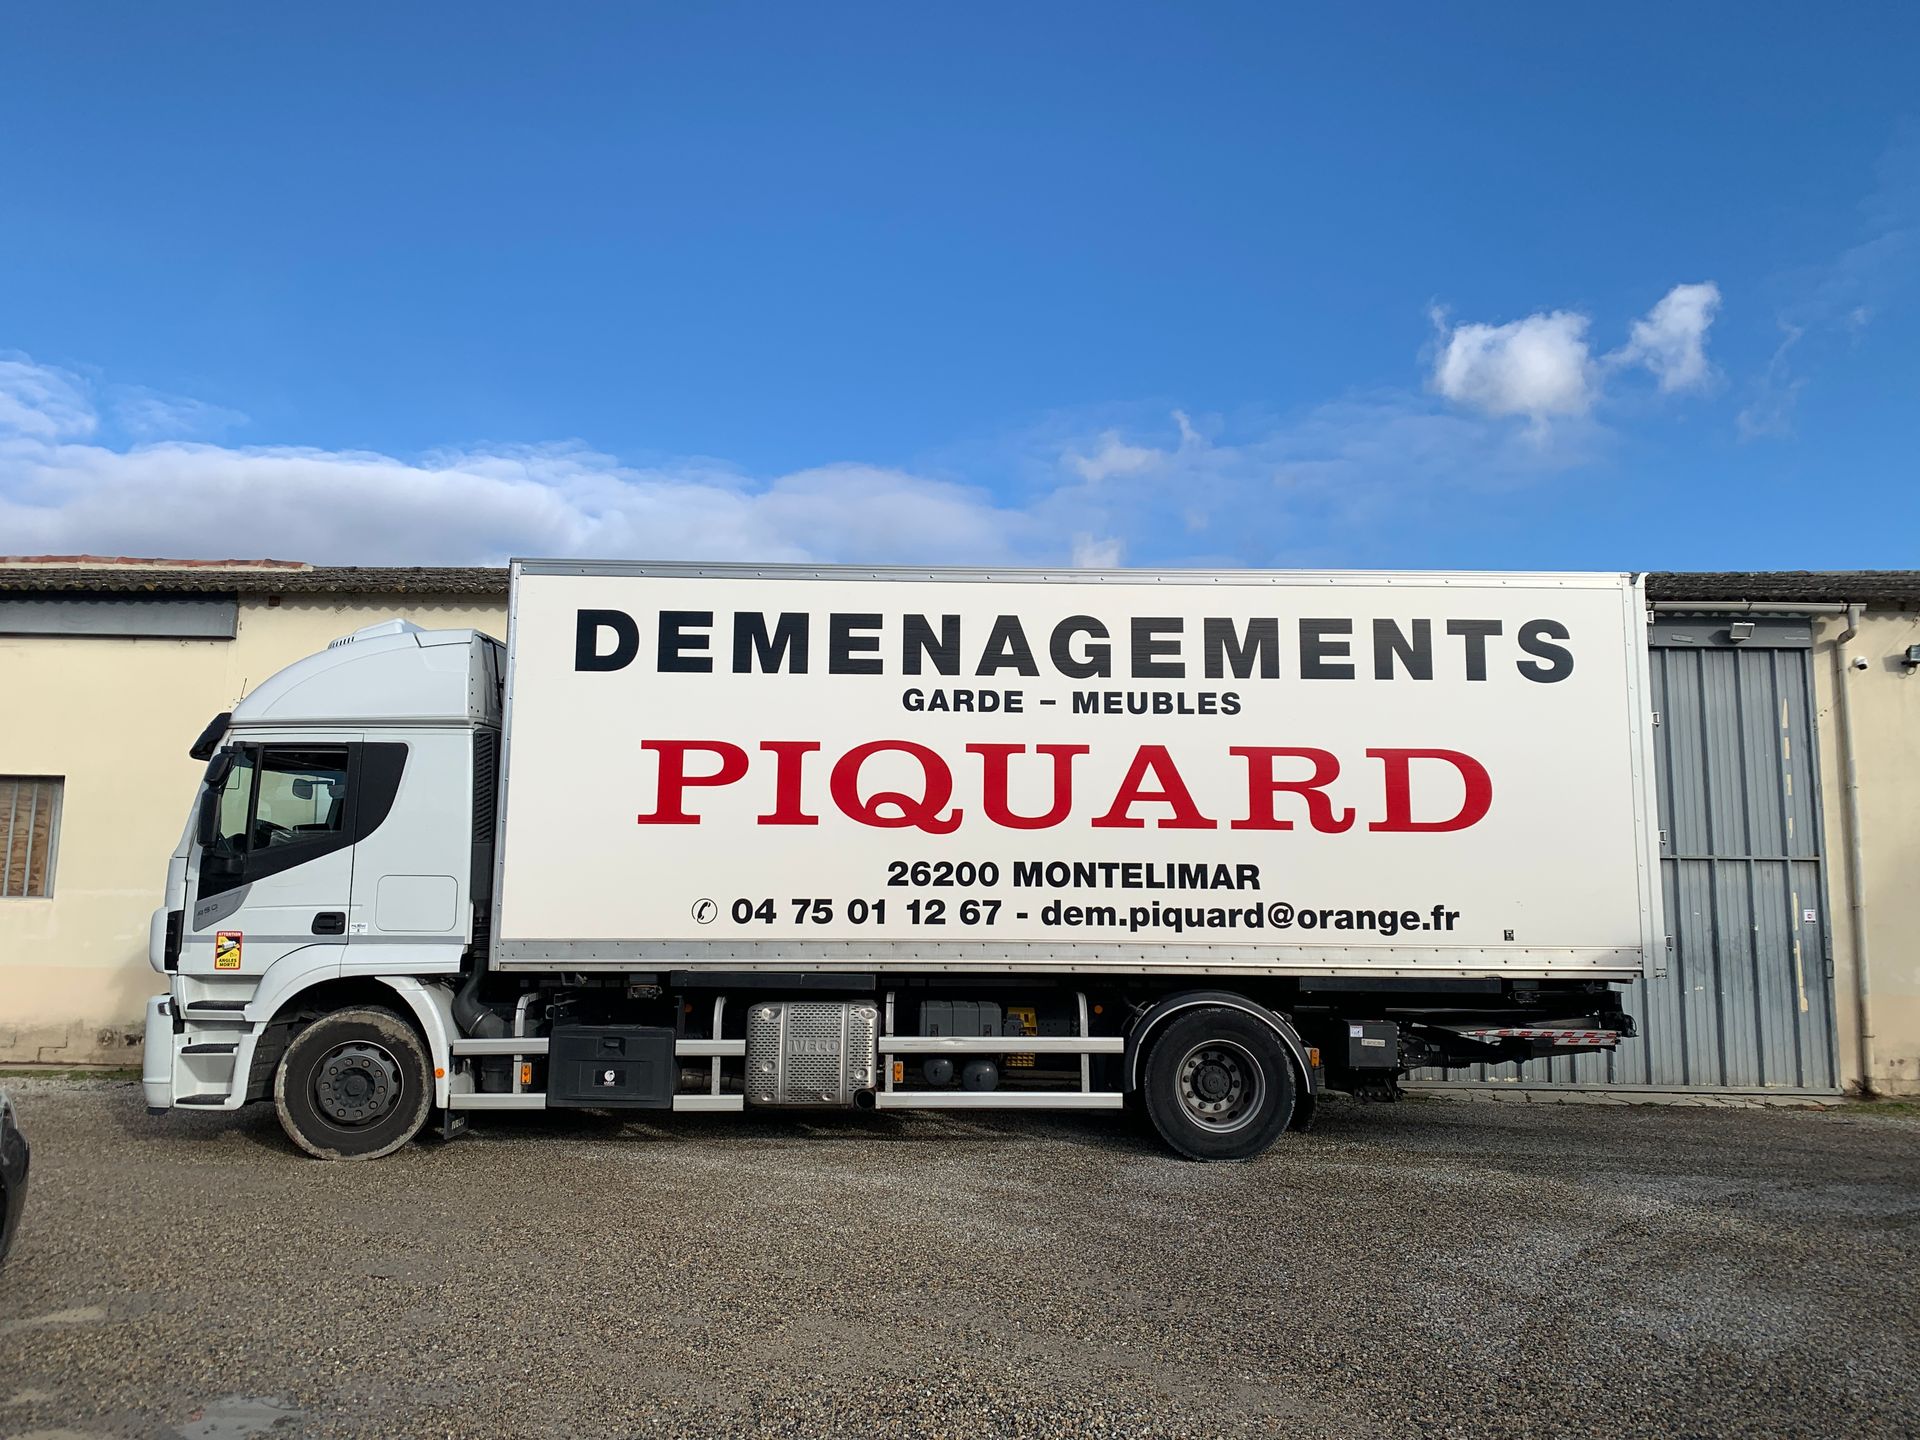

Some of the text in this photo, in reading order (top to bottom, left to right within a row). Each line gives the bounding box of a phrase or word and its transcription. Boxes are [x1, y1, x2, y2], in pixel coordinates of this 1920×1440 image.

[575, 609, 1573, 683] DEMENAGEMENTS
[903, 688, 1023, 713] GARDE
[1073, 691, 1242, 715] MEUBLES
[638, 739, 1493, 834] PIQUARD
[888, 861, 1260, 890] 26200 MONTELIMAR
[731, 899, 777, 925] 04
[791, 899, 834, 925] 75
[847, 899, 886, 925] 01
[906, 899, 946, 925] 12
[960, 900, 1002, 926] 67
[1041, 900, 1460, 937] dem.piquard@orange.fr
[787, 1040, 840, 1053] IVECO
